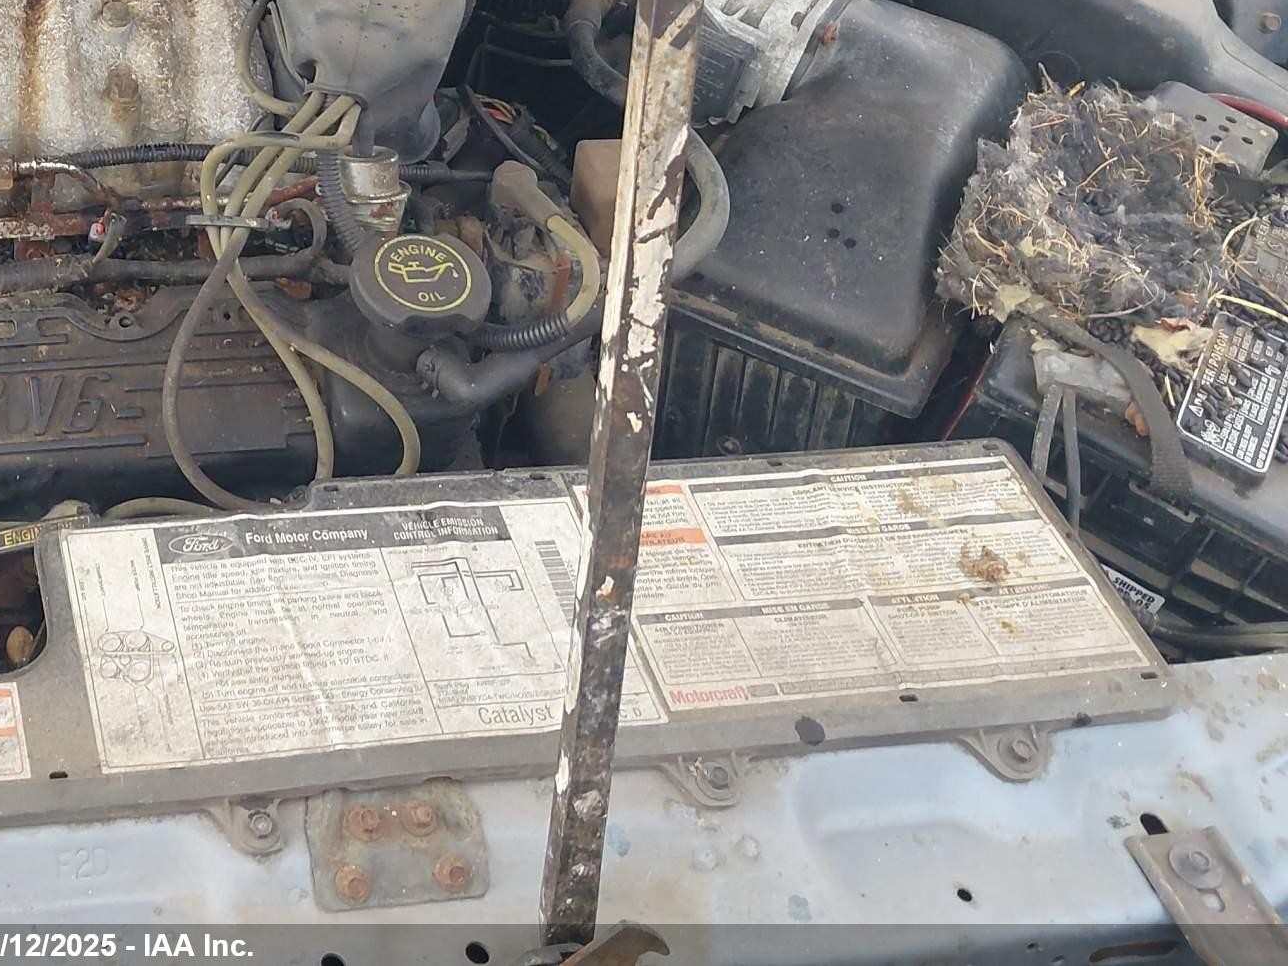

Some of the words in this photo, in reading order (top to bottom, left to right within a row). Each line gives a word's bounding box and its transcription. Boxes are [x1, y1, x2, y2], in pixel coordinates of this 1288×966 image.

[390, 244, 447, 263] ENGINE
[417, 290, 447, 302] OIL
[830, 474, 867, 484] CAUTION
[402, 519, 439, 531] VEHICLE
[441, 517, 484, 528] EMISSION
[245, 531, 272, 544] Ford
[275, 530, 309, 544] Motor
[312, 528, 368, 542] Company
[393, 528, 436, 540] CONTROL
[438, 525, 498, 537] INFORMATION
[183, 536, 220, 552] Ford
[230, 558, 267, 570] equipped
[172, 573, 200, 583] Engine
[1112, 576, 1156, 604] SHIPPED
[665, 612, 705, 622] CAUTION
[669, 684, 748, 705] Motorcraft
[478, 702, 555, 727] Catalyst
